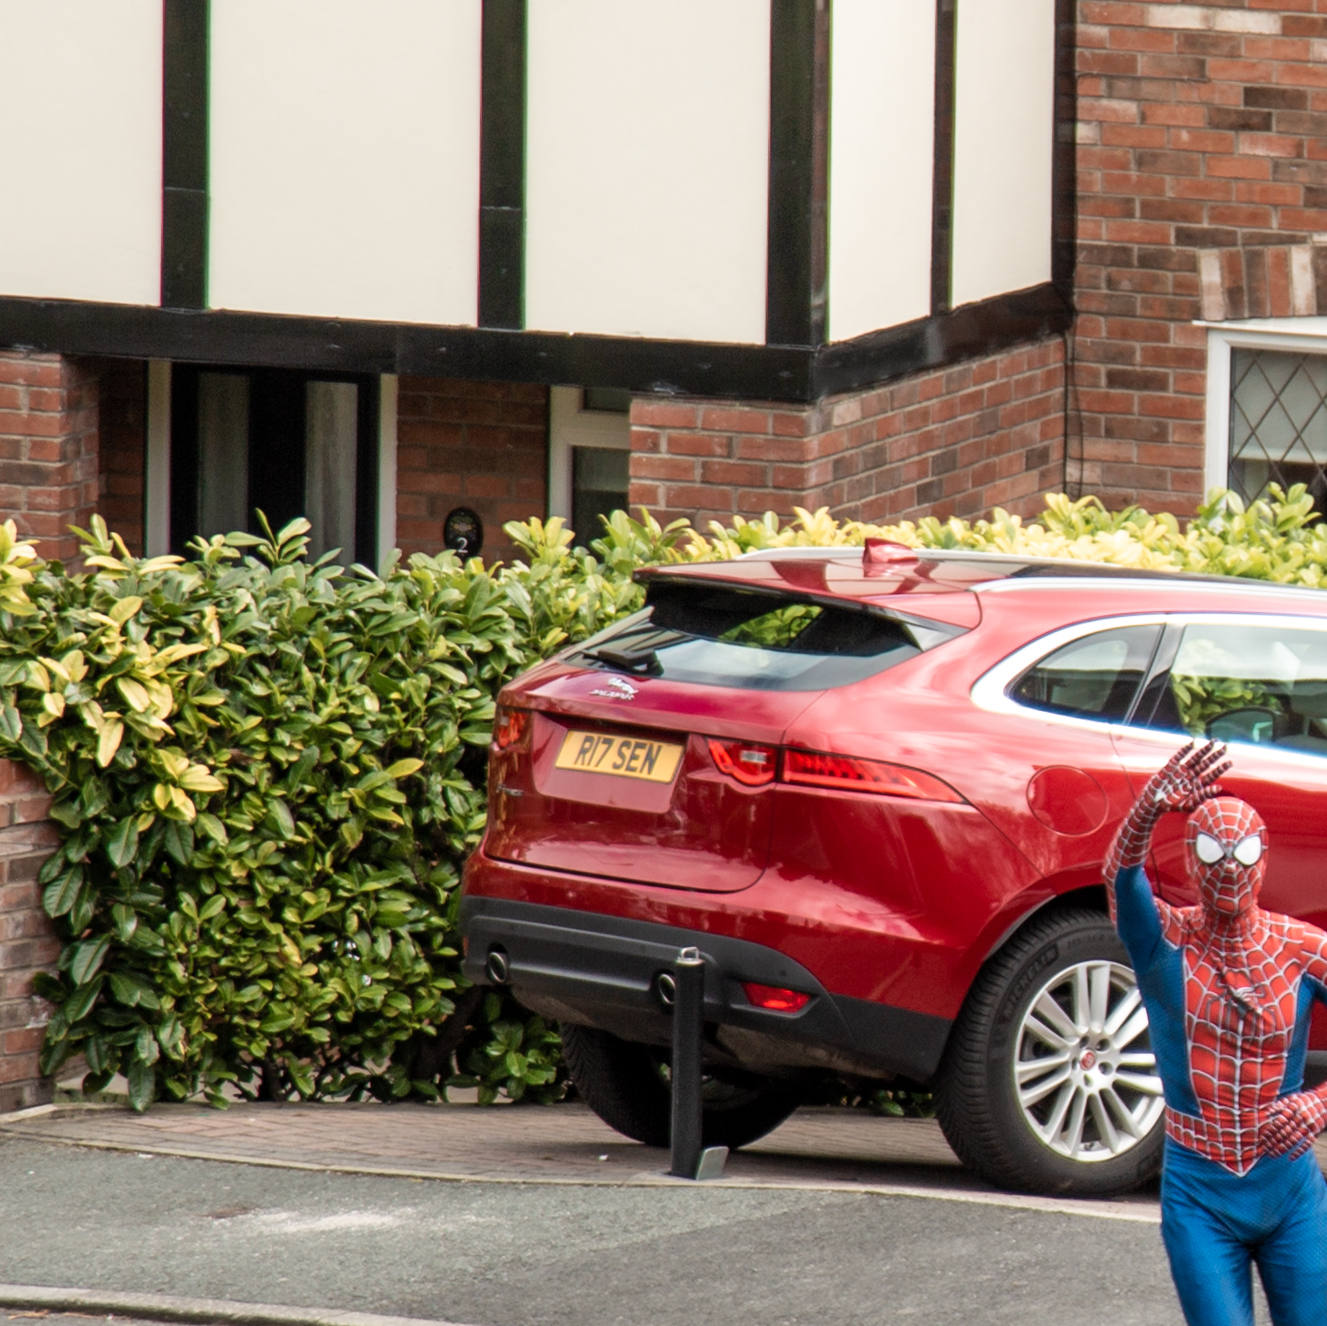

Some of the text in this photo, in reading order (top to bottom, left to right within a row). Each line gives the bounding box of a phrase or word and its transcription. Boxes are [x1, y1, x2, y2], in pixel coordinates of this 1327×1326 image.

[457, 537, 469, 553] 2
[574, 735, 663, 775] R17 SEN
